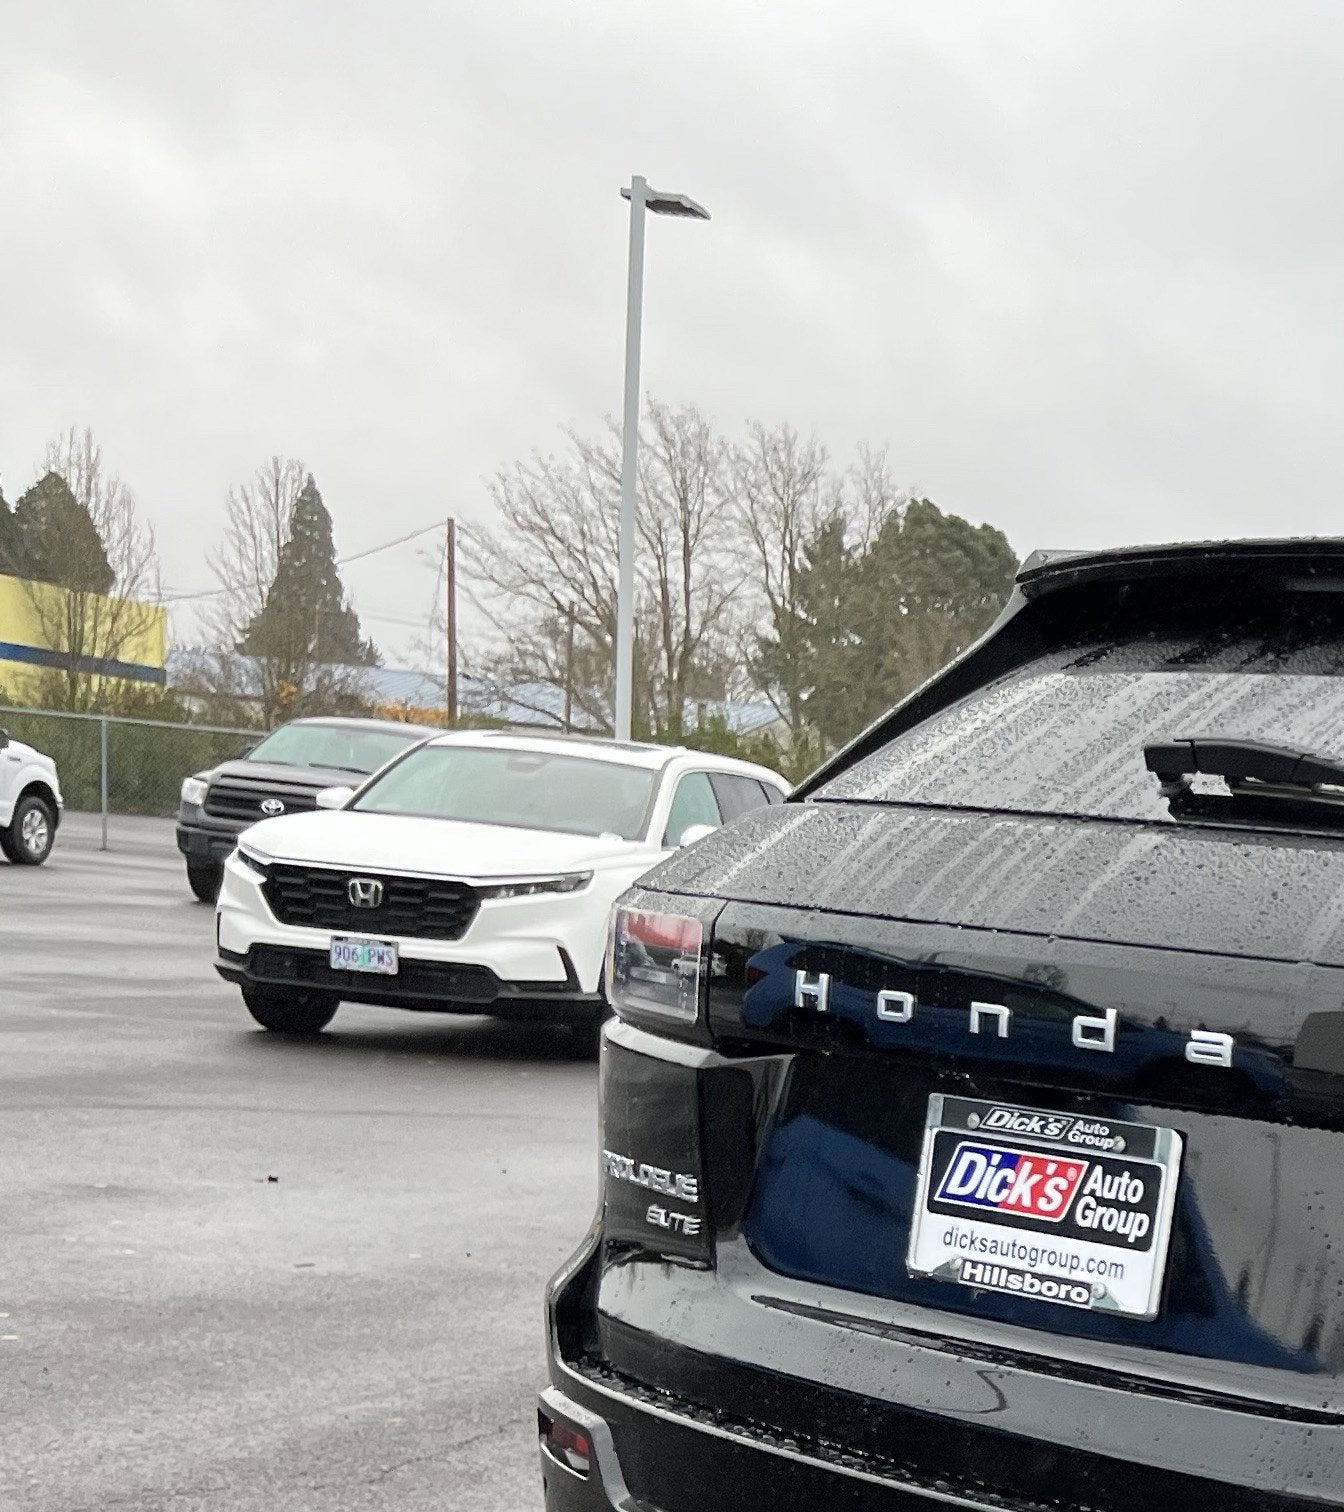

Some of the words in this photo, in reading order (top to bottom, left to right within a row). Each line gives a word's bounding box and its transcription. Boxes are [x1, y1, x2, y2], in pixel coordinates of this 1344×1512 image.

[334, 945, 359, 963] 906
[794, 970, 1234, 1068] Honda
[985, 1110, 1063, 1136] Dick's
[1067, 1130, 1114, 1150] Group
[1072, 1119, 1110, 1136] Auto
[945, 1150, 1069, 1212] Dick's
[1083, 1165, 1144, 1204] Auto
[1075, 1196, 1150, 1243] Group
[943, 1227, 1126, 1280] dicksautogroup.com
[962, 1261, 1090, 1303] Hillsboro
